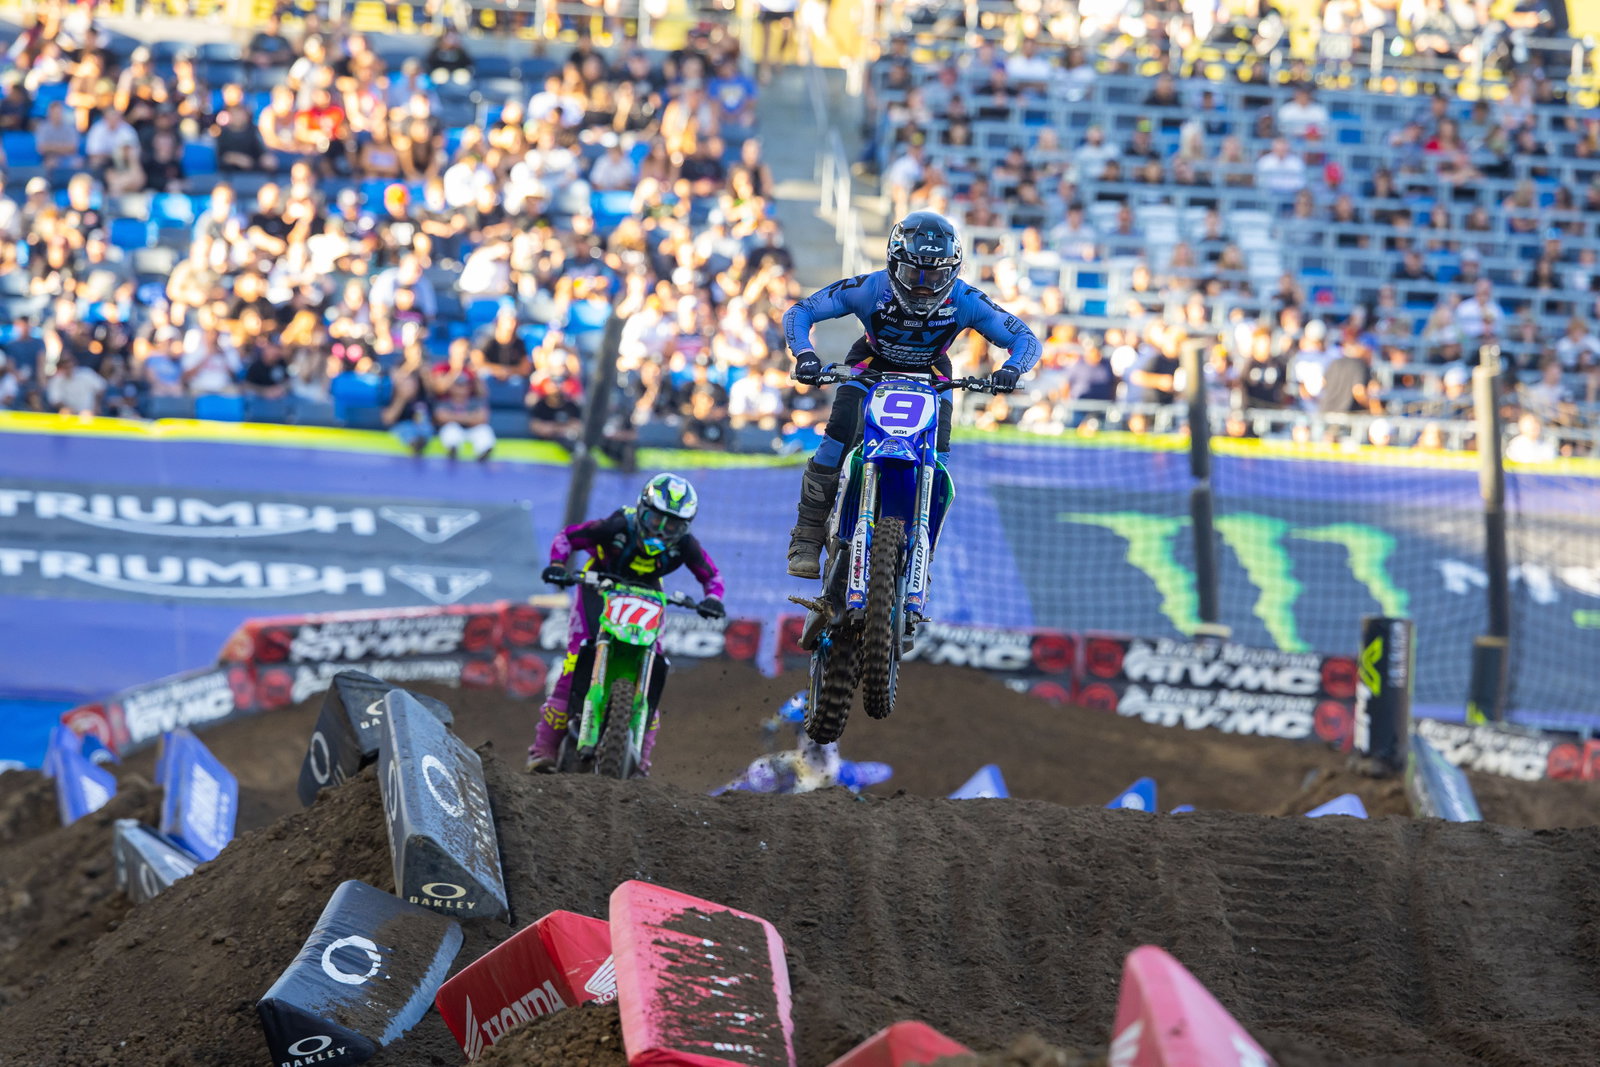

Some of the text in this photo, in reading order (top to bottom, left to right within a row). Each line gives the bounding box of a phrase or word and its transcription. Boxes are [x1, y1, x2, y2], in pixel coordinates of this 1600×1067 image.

[877, 325, 946, 345] FLY
[880, 393, 926, 428] 9
[0, 489, 376, 537] TRIUMPH
[0, 548, 386, 598] TRIUMPH
[913, 541, 924, 590] DUNLOP
[610, 596, 661, 631] 177
[409, 895, 476, 909] OAKLEY
